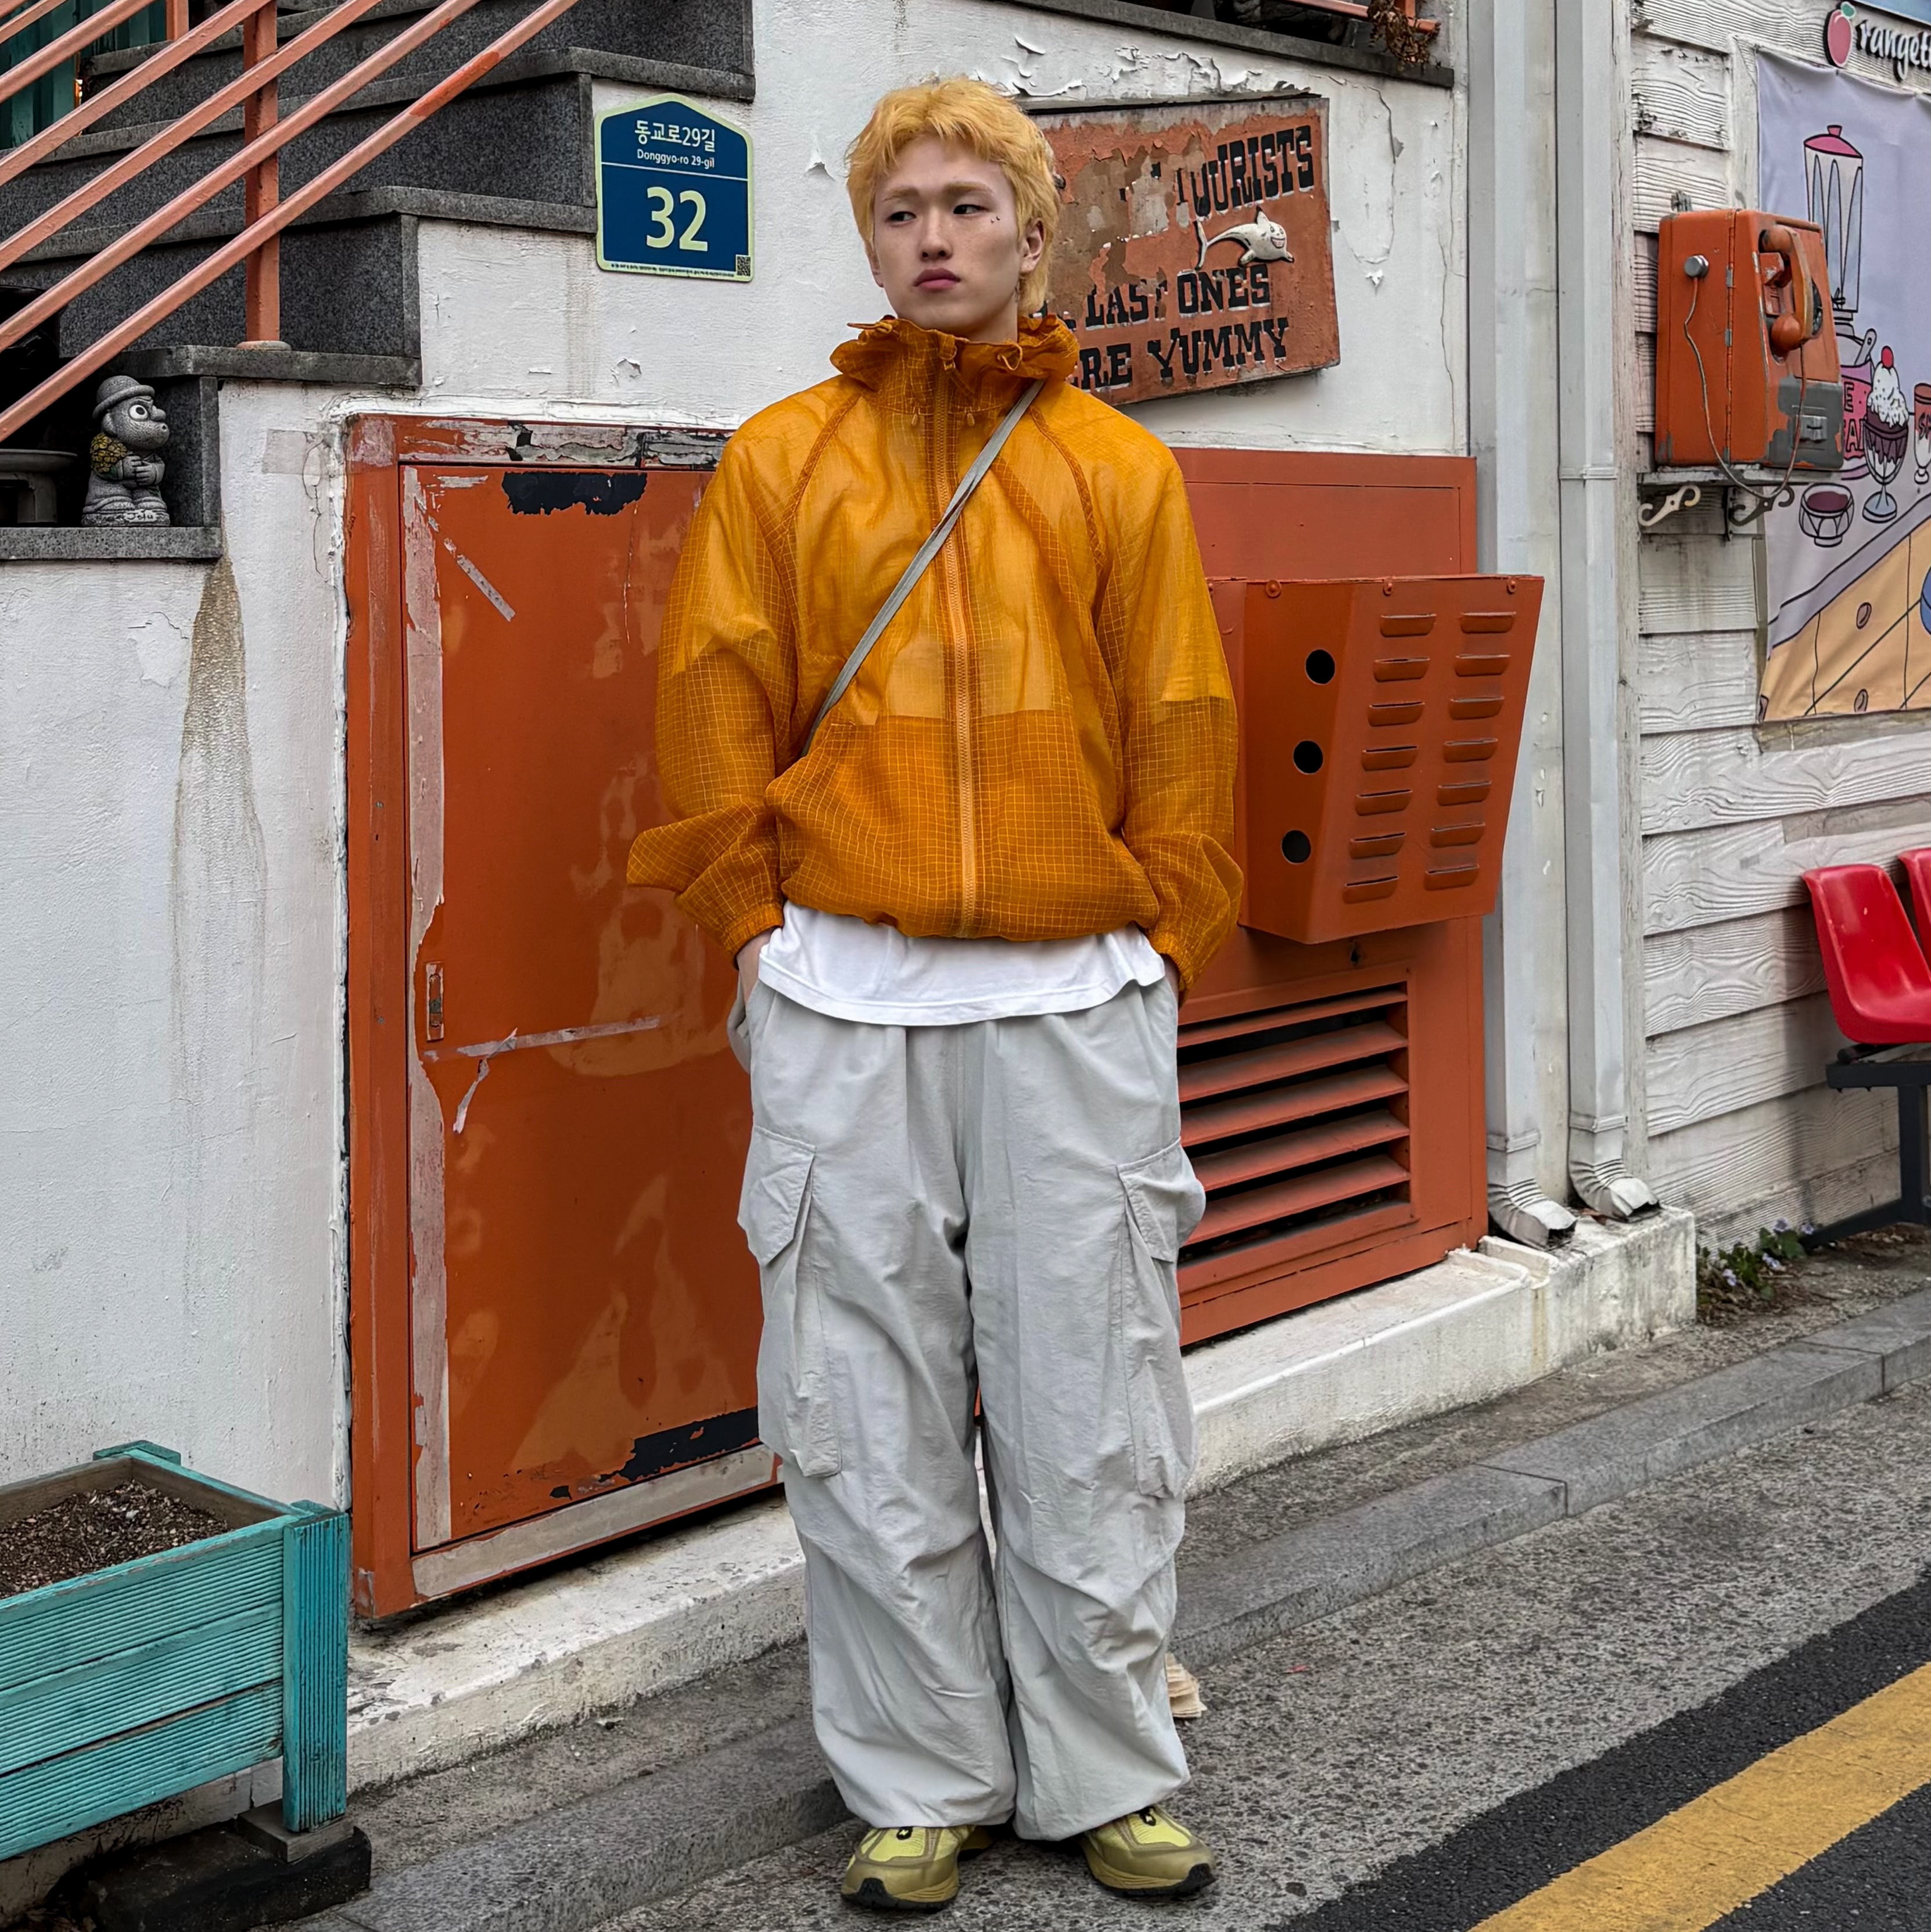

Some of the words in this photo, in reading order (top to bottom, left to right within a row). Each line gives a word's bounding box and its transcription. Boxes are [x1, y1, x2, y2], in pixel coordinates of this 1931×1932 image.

[1856, 20, 1931, 81] ranget
[634, 120, 716, 153] 동교로29길
[637, 148, 690, 165] Donggyo-ro
[691, 155, 715, 170] 29-gil
[646, 186, 708, 252] 32
[1177, 264, 1272, 318] ONES
[1072, 342, 1133, 393] RE
[1147, 317, 1290, 381] YUMMY
